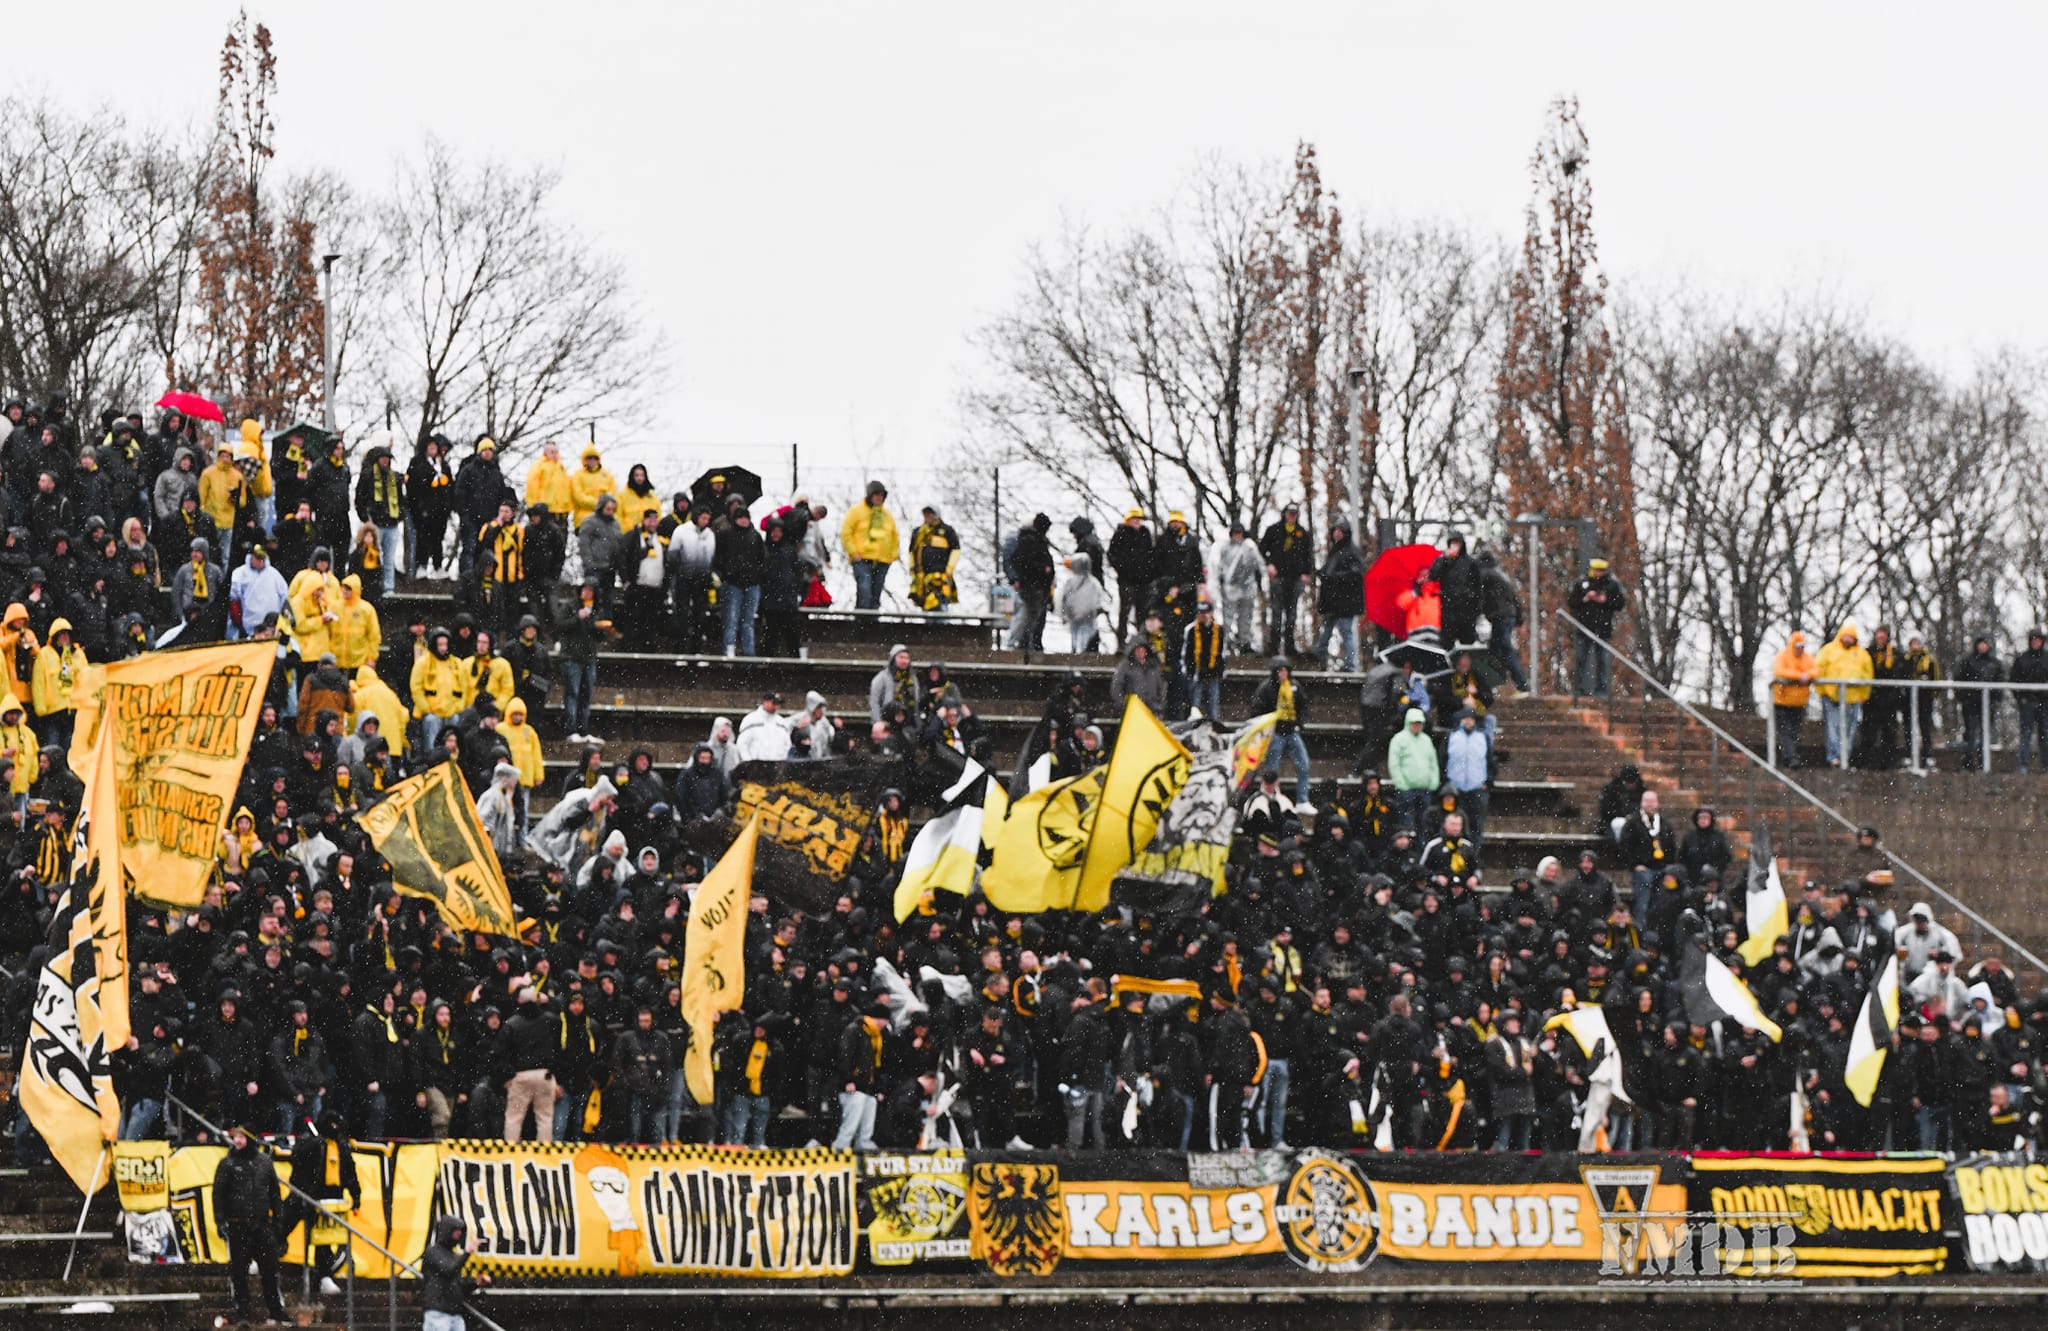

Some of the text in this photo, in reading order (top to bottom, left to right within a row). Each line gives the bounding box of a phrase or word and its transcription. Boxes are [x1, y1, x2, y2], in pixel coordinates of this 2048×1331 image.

[865, 1152, 967, 1176] FÜR STADT
[442, 1156, 578, 1258] YELLOW
[642, 1168, 852, 1269] CONNECTION
[1065, 1191, 1584, 1248] KARLS BANDE
[877, 1242, 914, 1260] UND
[1964, 1212, 2048, 1264] HOO
